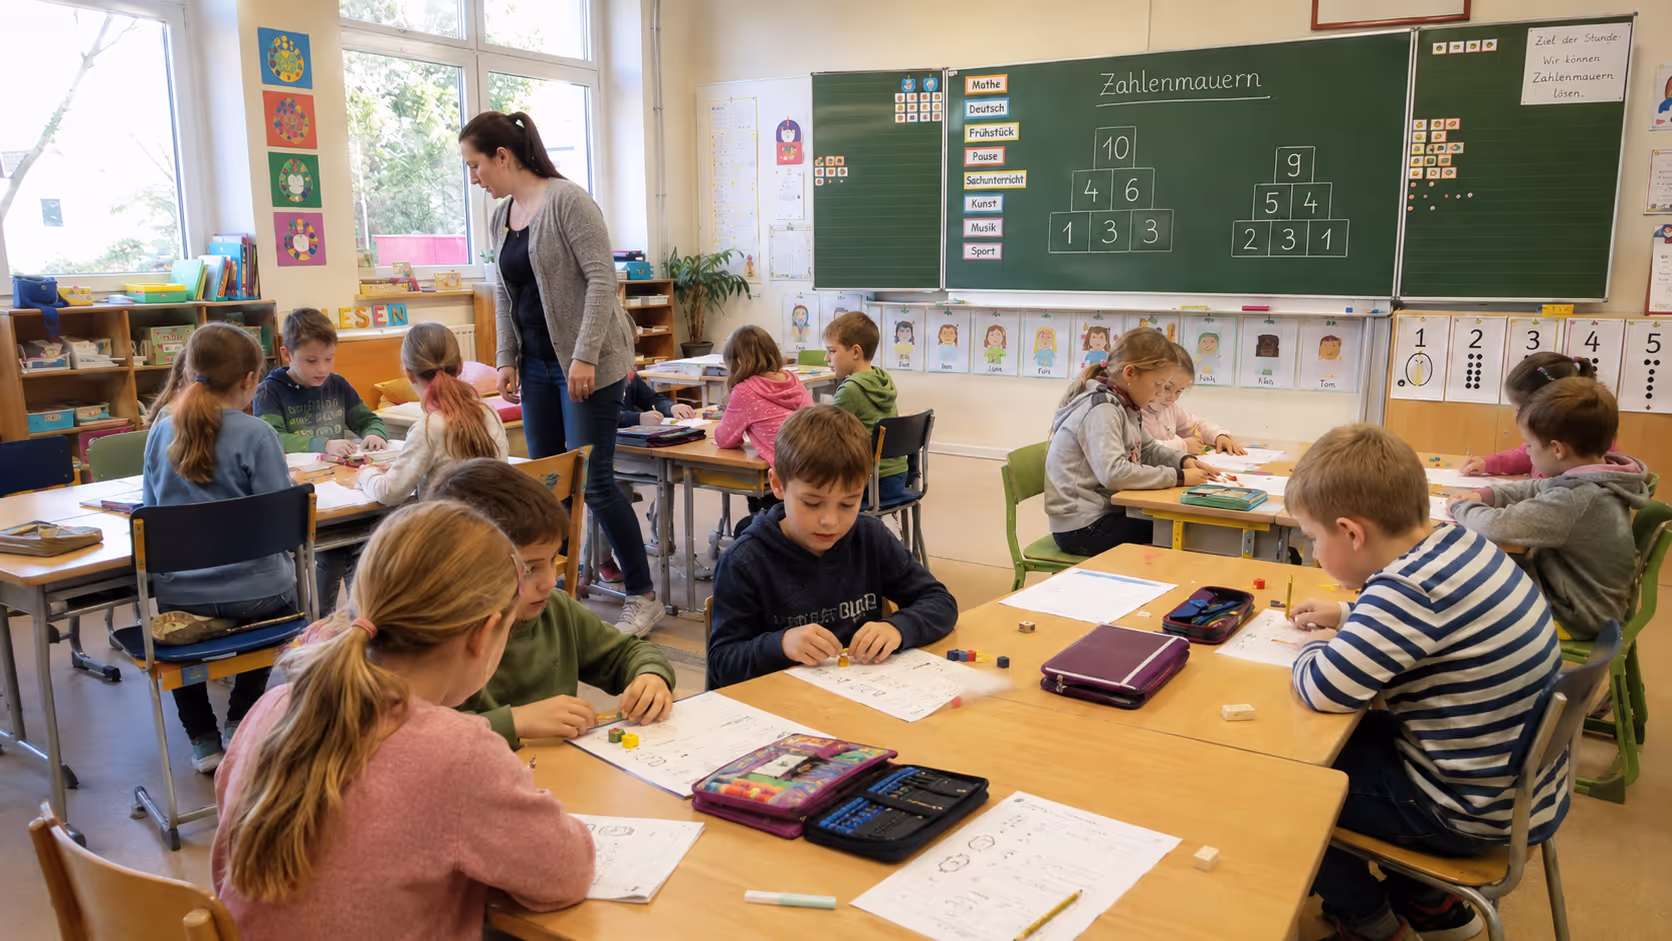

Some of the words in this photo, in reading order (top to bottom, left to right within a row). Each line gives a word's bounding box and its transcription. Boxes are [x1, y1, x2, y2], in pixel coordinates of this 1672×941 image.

[1535, 35, 1556, 46] Ziel
[1562, 35, 1579, 45] der
[1543, 55, 1560, 65] Wir
[971, 79, 1001, 90] Mathe
[1100, 69, 1262, 96] Zahlenmauern
[1532, 71, 1614, 84] Zahlenmauern
[1553, 88, 1585, 99] lösen.
[969, 103, 1005, 114] Deutsch
[969, 126, 1014, 138] Frühstück
[1102, 135, 1130, 160] 10
[1287, 153, 1302, 177] 9
[966, 175, 1025, 185] Sachunterricht
[1083, 179, 1099, 203] 4
[1125, 177, 1139, 202] 6
[971, 198, 997, 209] Kunst
[1264, 191, 1280, 214] 5
[1303, 191, 1319, 214] 4
[970, 222, 997, 233] Musik
[1062, 220, 1073, 244] 1
[1101, 219, 1118, 244] 3
[1142, 218, 1159, 244] 3
[1243, 228, 1258, 250] 2
[1281, 228, 1296, 251] 3
[1320, 227, 1332, 251] 1
[971, 246, 996, 258] Sport
[1414, 327, 1427, 348] 1
[1468, 328, 1483, 349] 2
[1525, 330, 1541, 351] 3
[1584, 330, 1601, 352] 4
[1645, 332, 1661, 354] 5
[1319, 379, 1336, 389] Tom
